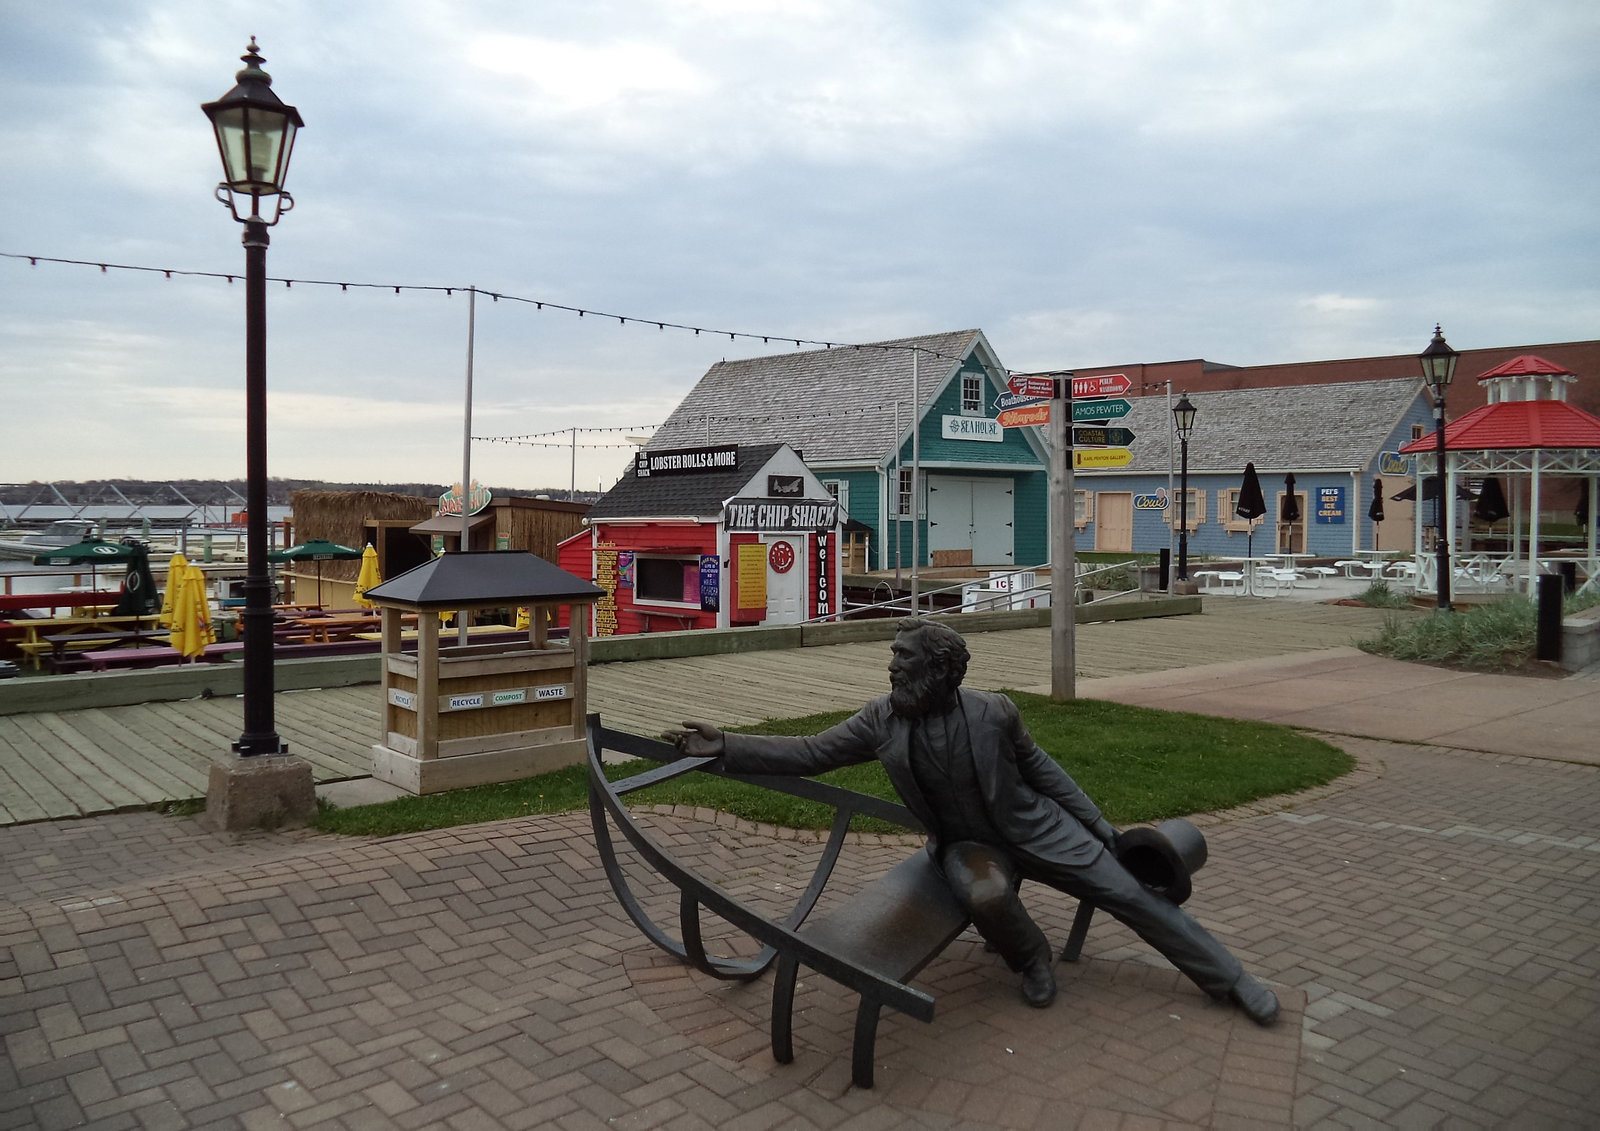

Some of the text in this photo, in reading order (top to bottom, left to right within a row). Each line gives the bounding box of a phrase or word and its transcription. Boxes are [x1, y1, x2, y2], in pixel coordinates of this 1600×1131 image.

[1075, 404, 1124, 416] AMOS PEWTER
[639, 460, 648, 468] CHIP
[650, 451, 736, 470] LOBSTER ROLLS & MORE
[637, 469, 650, 477] SHACK
[1137, 496, 1165, 508] Cows
[729, 504, 836, 527] THE CHIP SHACK
[538, 688, 563, 697] WASTE
[395, 694, 410, 705] RECYCLE
[452, 698, 480, 707] RECYCLE
[495, 694, 522, 702] COMPOST
